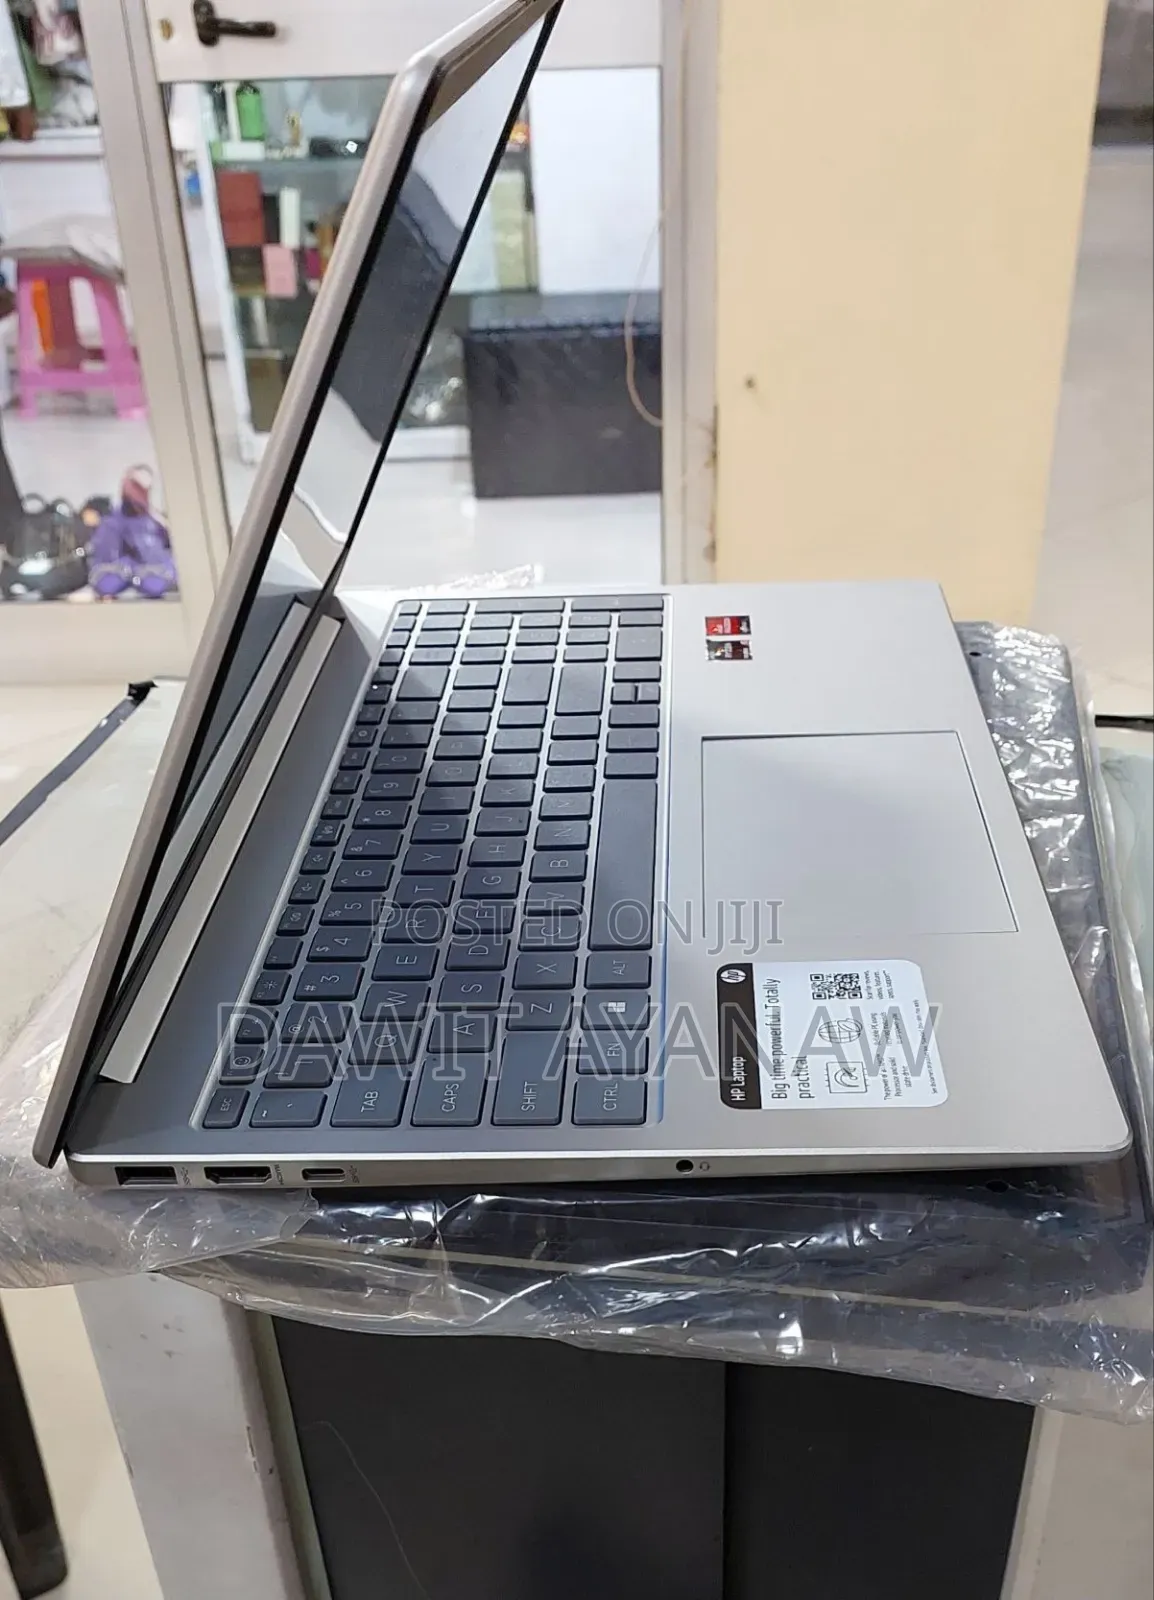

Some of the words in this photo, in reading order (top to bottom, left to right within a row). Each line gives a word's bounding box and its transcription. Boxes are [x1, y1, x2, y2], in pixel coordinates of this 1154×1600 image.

[550, 859, 569, 868] B
[355, 869, 373, 877] 6
[482, 875, 502, 885] G
[414, 885, 434, 893] T
[344, 902, 362, 910] 5
[334, 937, 351, 946] 4
[395, 955, 418, 965] E
[536, 963, 557, 973] X
[611, 959, 626, 976] ALT
[320, 974, 340, 984] 3
[461, 983, 483, 993] S
[762, 978, 782, 1010] Totally
[384, 990, 408, 1008] W
[530, 1002, 553, 1014] Z
[453, 1022, 475, 1035] A
[730, 1056, 748, 1087] Laptop
[769, 1059, 787, 1081] time
[790, 1055, 816, 1099] practical
[441, 1083, 460, 1112] CAPS
[521, 1081, 538, 1112] SHIFT
[603, 1082, 618, 1111] CTRL
[731, 1088, 746, 1101] HP
[771, 1083, 790, 1100] Big
[220, 1097, 232, 1112] ESC
[360, 1090, 379, 1113] TAB
